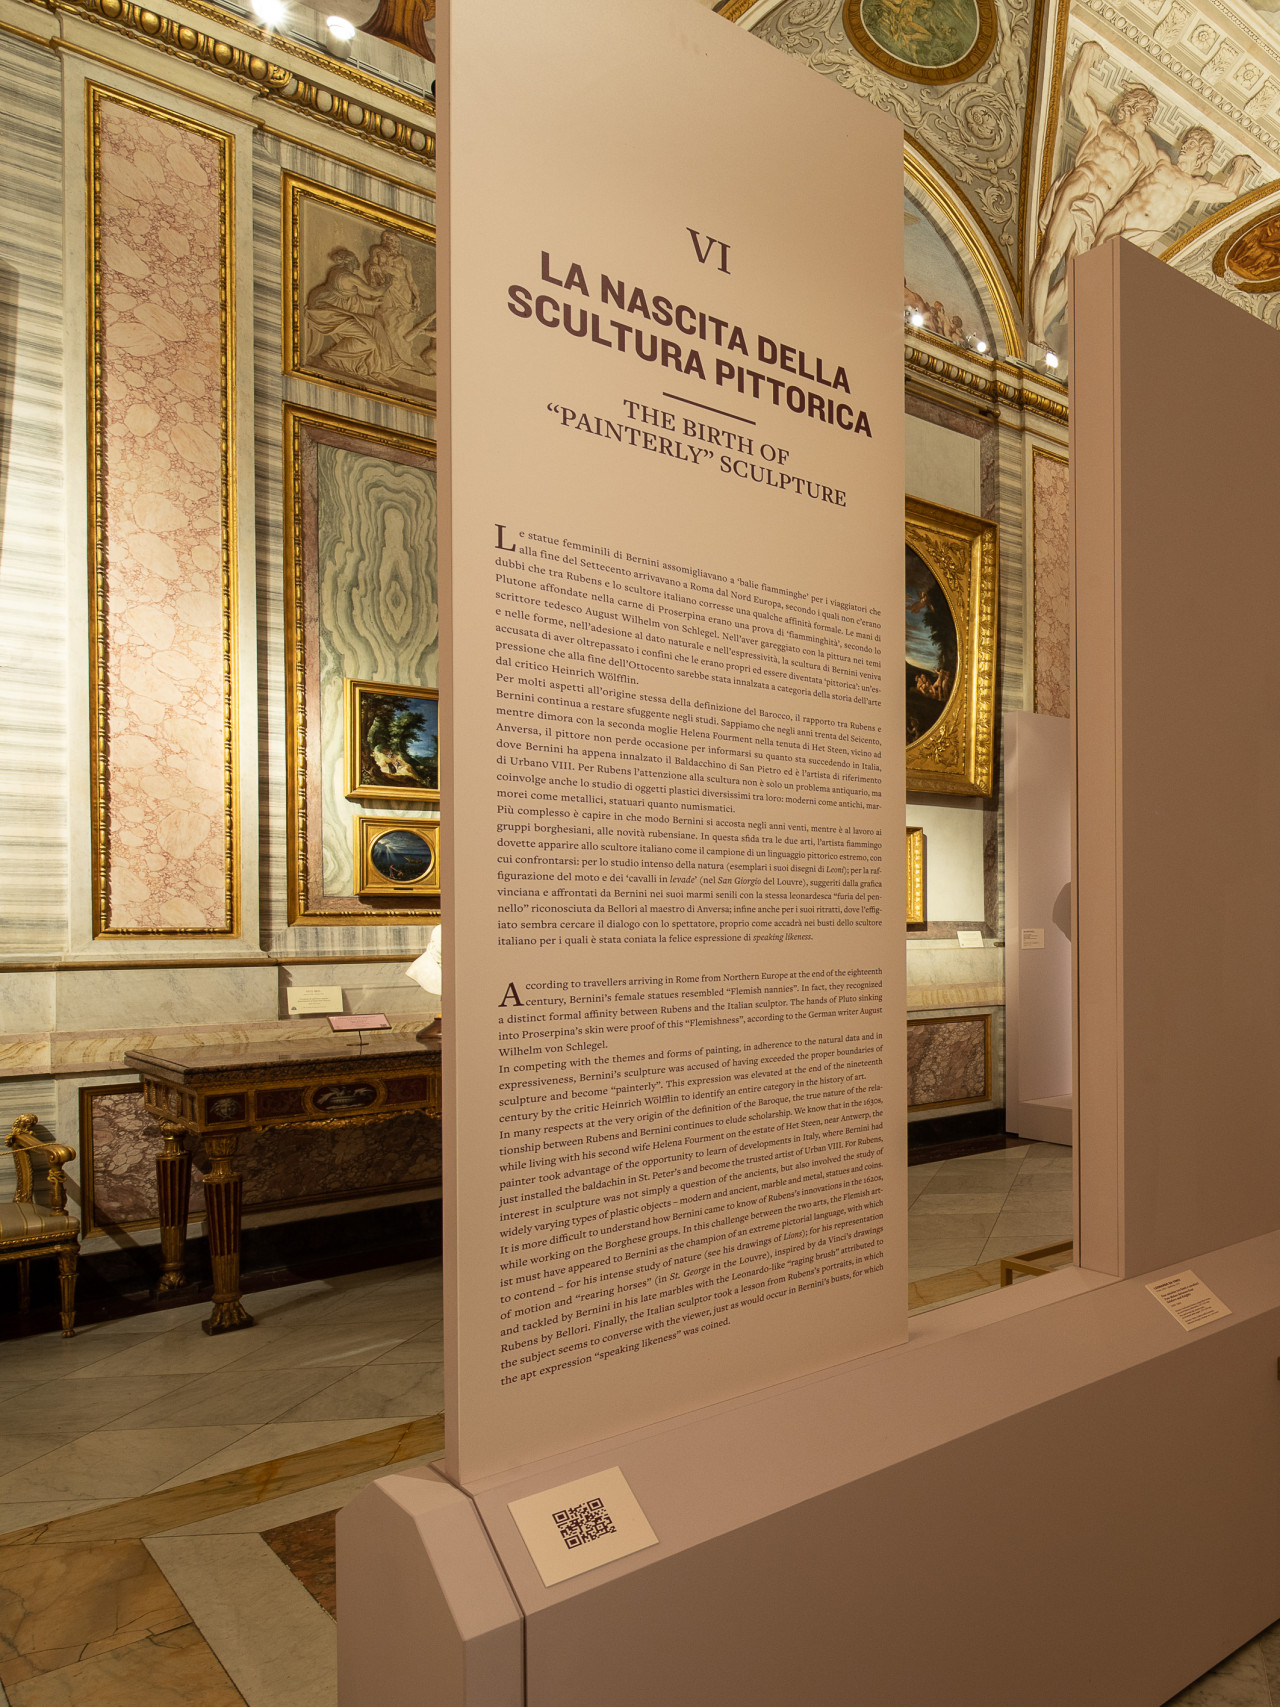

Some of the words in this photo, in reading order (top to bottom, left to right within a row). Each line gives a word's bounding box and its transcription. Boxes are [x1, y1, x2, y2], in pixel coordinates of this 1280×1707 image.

[685, 226, 732, 275] VI
[540, 250, 591, 298] LA
[600, 273, 750, 357] NASCITA
[757, 334, 852, 395] DELLA
[507, 284, 707, 381] SCULTURA
[715, 357, 873, 439] PITTORICA
[546, 402, 715, 465] “PAINTERLY”
[719, 455, 847, 508] SCULPTURE
[622, 398, 676, 432] THE
[682, 417, 754, 457] BIRTH
[759, 443, 790, 466] OF
[494, 556, 525, 571] dubbi
[527, 564, 546, 575] che
[548, 569, 564, 579] tra
[566, 571, 602, 586] Rubens
[612, 580, 622, 590] lo
[624, 585, 662, 598] scultore
[663, 591, 697, 605] italiano
[698, 600, 734, 613] corresse
[735, 607, 751, 616] una
[752, 611, 783, 623] qualche
[784, 616, 812, 629] affinità
[845, 628, 855, 637] Le
[855, 632, 873, 641] mani
[874, 634, 882, 642] di
[495, 591, 541, 606] scrittore
[544, 600, 583, 614] tedesco
[585, 607, 618, 621] August
[621, 613, 661, 628] Wilhelm
[662, 622, 680, 632] von
[681, 624, 720, 639] Schlegel.
[760, 641, 801, 654] gareggiato
[802, 648, 816, 657] con
[817, 649, 825, 658] la
[826, 652, 852, 663] pittura
[853, 657, 864, 665] nei
[865, 659, 882, 668] temi
[495, 655, 512, 667] dal
[514, 660, 549, 672] critico
[551, 664, 595, 679] Heinrich
[597, 671, 639, 685] Wölfflin.
[495, 722, 542, 737] Anversa,
[545, 727, 552, 737] il
[555, 729, 591, 741] pittore
[593, 734, 612, 743] non
[615, 736, 642, 746] perde
[644, 740, 689, 751] occasione
[691, 745, 706, 754] per
[708, 745, 752, 758] informarsi
[765, 753, 793, 762] quanto
[794, 756, 807, 764] sta
[808, 758, 851, 768] succedendo
[852, 761, 860, 769] in
[496, 790, 528, 799] morei
[530, 792, 558, 801] come
[561, 794, 607, 806] metallici,
[609, 798, 645, 807] statuari
[647, 801, 679, 810] quanto
[680, 802, 736, 813] numismatici.
[496, 822, 531, 834] gruppi
[533, 822, 595, 836] borghesiani,
[596, 826, 614, 836] alle
[616, 828, 646, 838] novità
[648, 829, 698, 840] rubensiane.
[700, 832, 710, 841] In
[712, 834, 739, 844] questa
[741, 834, 760, 843] sfida
[761, 836, 774, 844] tra
[775, 835, 783, 844] le
[784, 836, 799, 845] due
[846, 839, 883, 851] fiammingo
[498, 1017, 505, 1025] a
[506, 1013, 546, 1024] distinct
[549, 1010, 582, 1021] formal
[584, 1009, 618, 1020] affinity
[619, 1007, 658, 1017] between
[660, 1005, 692, 1014] Rubens
[694, 1002, 710, 1012] and
[711, 1002, 726, 1011] the
[727, 1001, 753, 1010] Italian
[789, 997, 805, 1006] The
[806, 996, 828, 1005] hands
[828, 995, 838, 1004] of
[838, 995, 857, 1003] Pluto
[858, 993, 883, 1003] sinking
[497, 1045, 543, 1057] Wilhelm
[544, 1045, 563, 1053] von
[565, 1040, 608, 1052] Schlegel.
[498, 1076, 577, 1092] expressiveness,
[579, 1070, 622, 1082] Bernini’s
[624, 1067, 666, 1078] sculpture
[668, 1065, 685, 1073] was
[686, 1060, 720, 1072] accused
[721, 1058, 731, 1068] of
[732, 1057, 759, 1067] having
[760, 1052, 795, 1064] exceeded
[796, 1052, 810, 1060] the
[810, 1051, 836, 1061] proper
[836, 1046, 875, 1057] boundaries
[875, 1044, 884, 1053] of
[498, 1112, 539, 1123] century
[540, 1109, 554, 1120] by
[555, 1106, 572, 1116] the
[573, 1103, 600, 1114] critic
[601, 1098, 642, 1111] Heinrich
[643, 1094, 679, 1106] Wölfflin
[681, 1094, 691, 1102] to
[692, 1088, 725, 1100] identify
[737, 1085, 762, 1095] entire
[763, 1082, 796, 1092] category
[796, 1079, 805, 1088] in
[805, 1078, 818, 1087] the
[819, 1076, 845, 1085] history
[845, 1073, 854, 1082] of
[500, 1337, 539, 1353] Rubens
[540, 1333, 554, 1344] by
[556, 1323, 591, 1339] Bellori.
[593, 1315, 628, 1330] Finally,
[629, 1311, 645, 1321] the
[646, 1303, 676, 1317] Italian
[677, 1294, 713, 1309] sculptor
[713, 1287, 733, 1300] took
[740, 1281, 766, 1293] lesson
[767, 1276, 786, 1286] from
[855, 1256, 863, 1264] in
[863, 1250, 884, 1262] which
[500, 1375, 518, 1386] the
[520, 1370, 537, 1382] apt
[539, 1355, 592, 1376] expression
[594, 1343, 640, 1361] “speaking
[641, 1329, 682, 1348] likeness”
[682, 1326, 700, 1337] was
